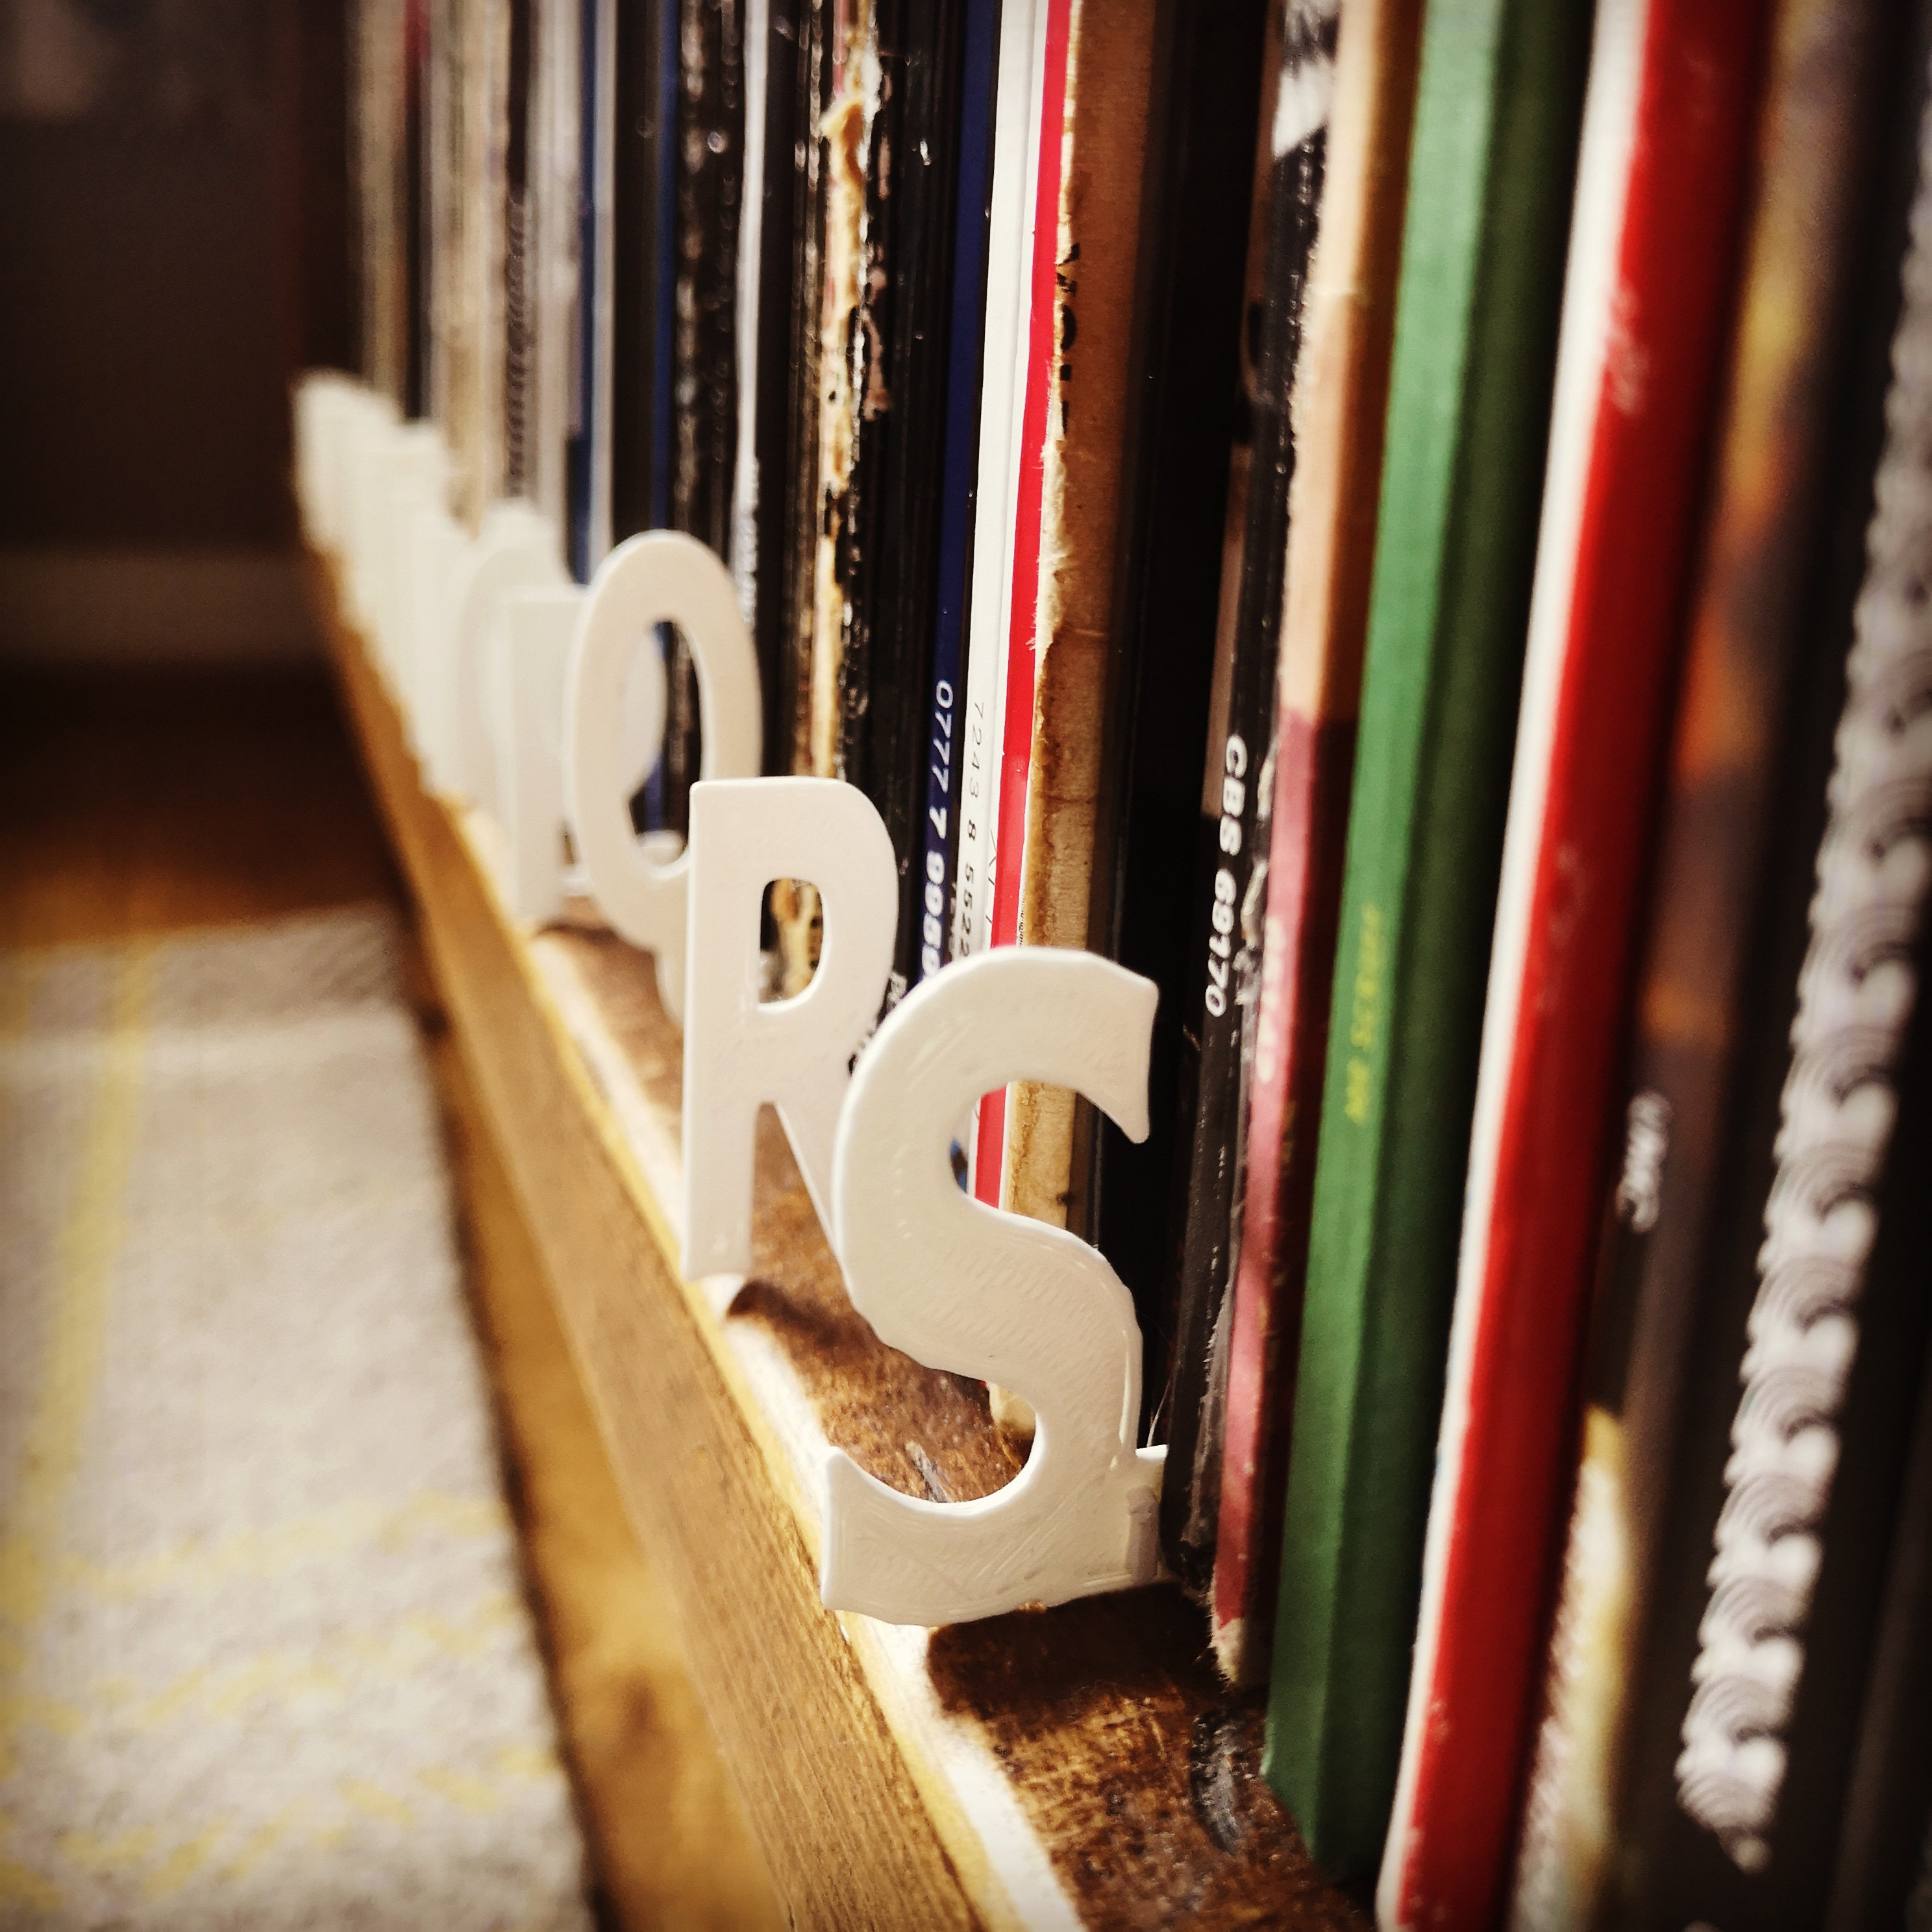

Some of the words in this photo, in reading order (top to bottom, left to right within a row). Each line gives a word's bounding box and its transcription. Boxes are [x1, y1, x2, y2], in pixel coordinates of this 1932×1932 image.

[564, 528, 763, 1027] Q
[932, 679, 954, 794] 0777
[969, 700, 985, 800] 7243
[1219, 733, 1248, 857] CBS
[929, 806, 948, 840] 7
[967, 819, 977, 841] 8
[1204, 868, 1237, 1017] 69170
[682, 776, 900, 1283] R
[822, 946, 1159, 1626] S
